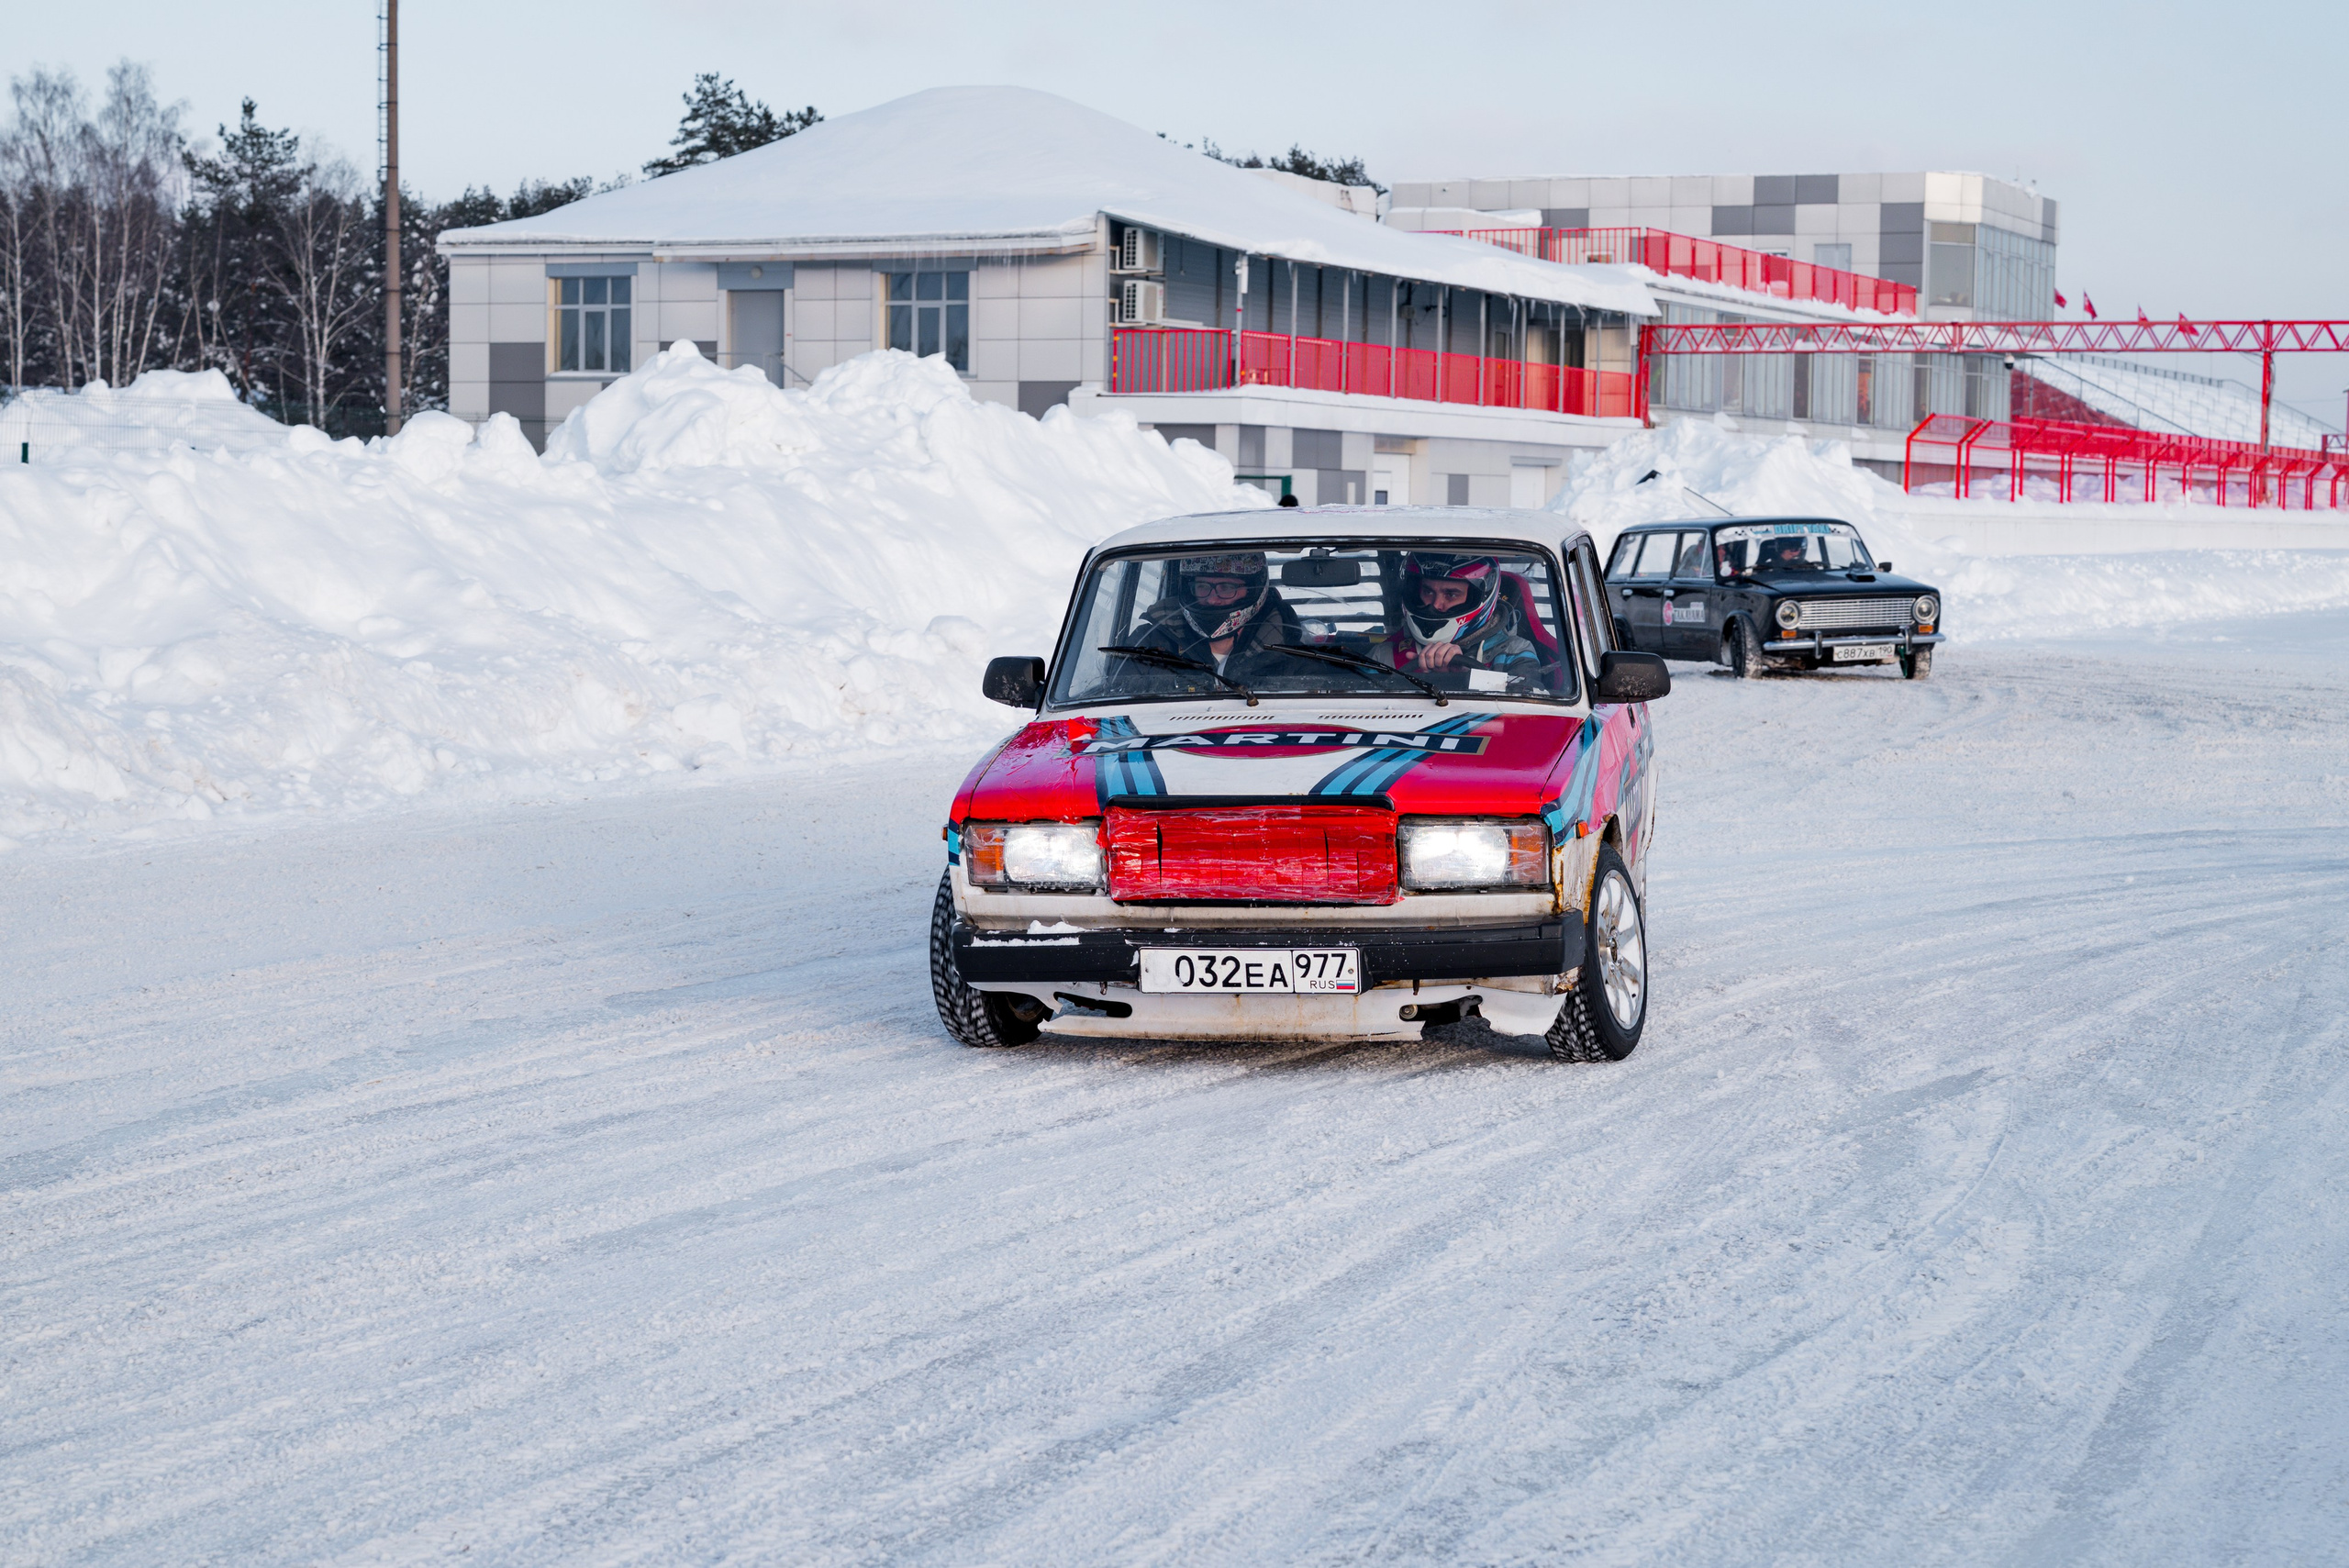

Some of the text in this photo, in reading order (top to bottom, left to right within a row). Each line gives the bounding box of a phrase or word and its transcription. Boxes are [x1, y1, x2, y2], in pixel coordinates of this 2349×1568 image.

[1775, 524, 1805, 534] DRIFT
[1878, 646, 1892, 654] 190
[1083, 732, 1460, 753] MARTINI
[1152, 952, 1347, 988] 032EA 977
[1309, 980, 1336, 990] RUS
